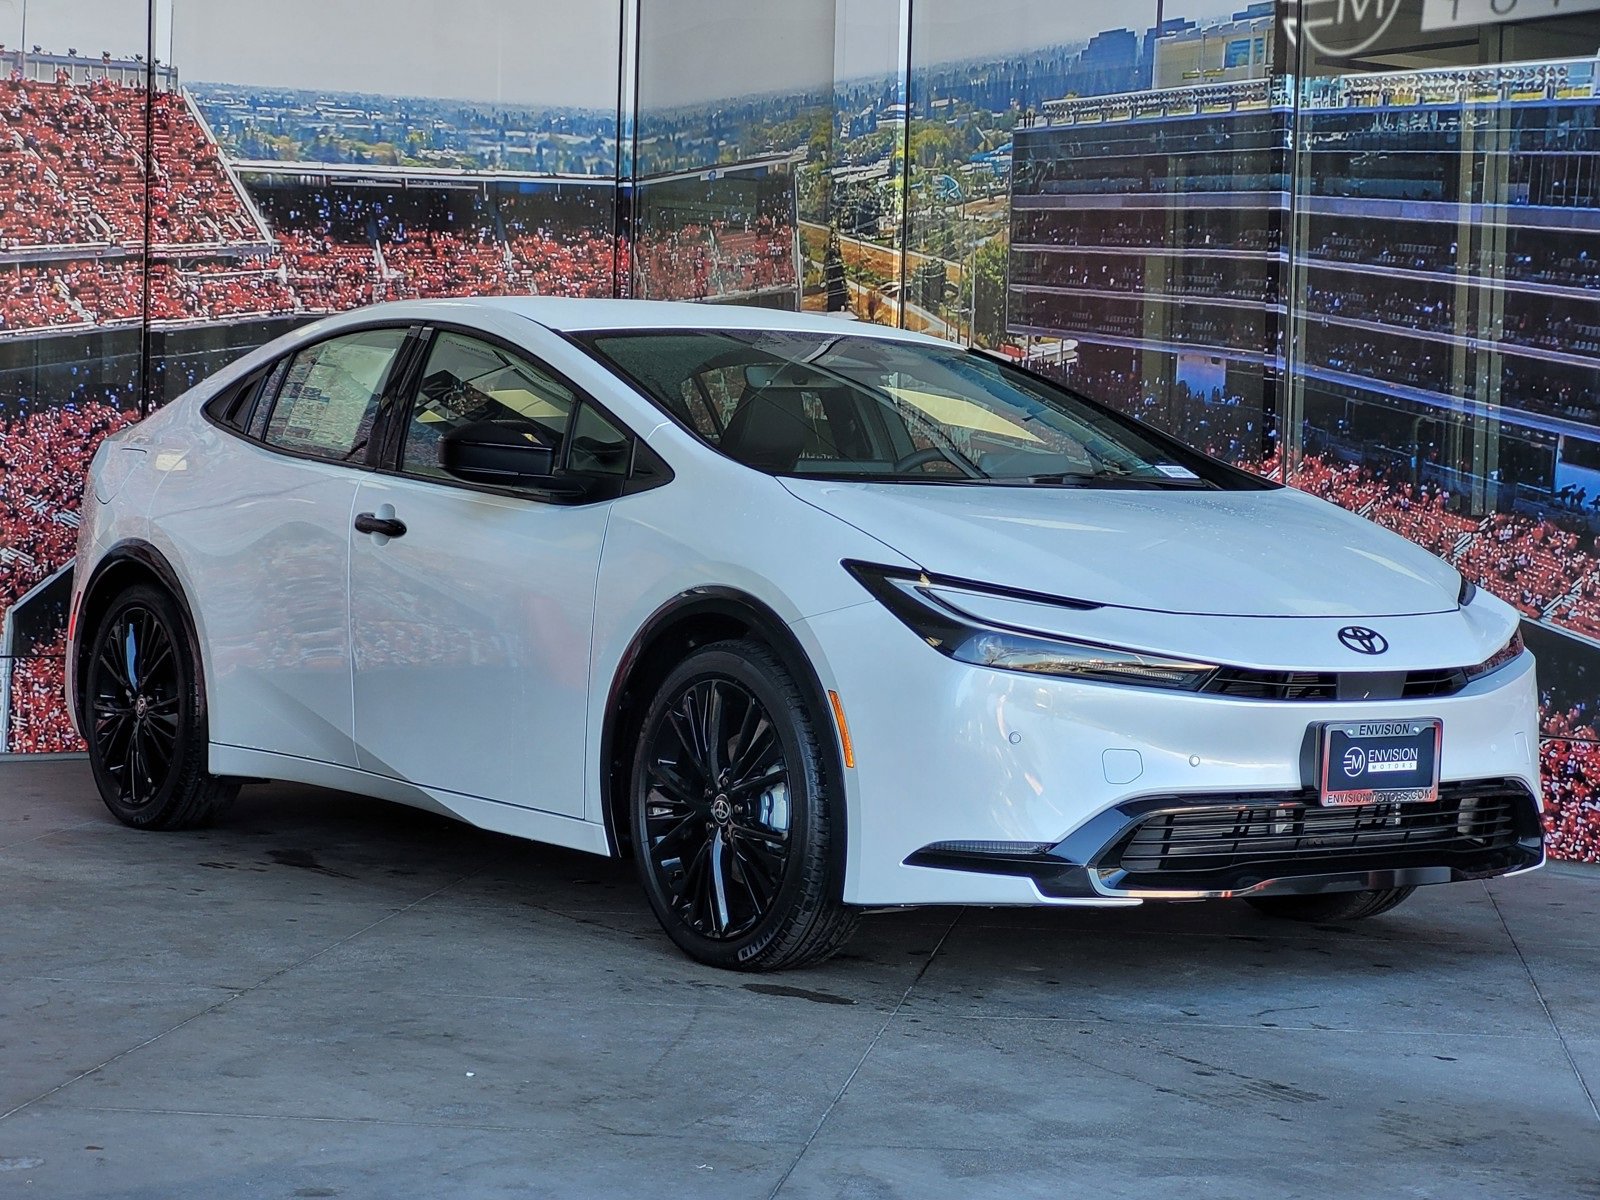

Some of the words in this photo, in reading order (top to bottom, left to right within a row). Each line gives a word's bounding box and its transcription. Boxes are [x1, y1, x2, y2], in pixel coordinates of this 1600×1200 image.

[1359, 723, 1411, 736] ENVISION
[1368, 747, 1419, 763] ENVISION
[1371, 762, 1414, 771] MOTORS
[1327, 788, 1432, 804] ENVISIONMOTORS.COM
